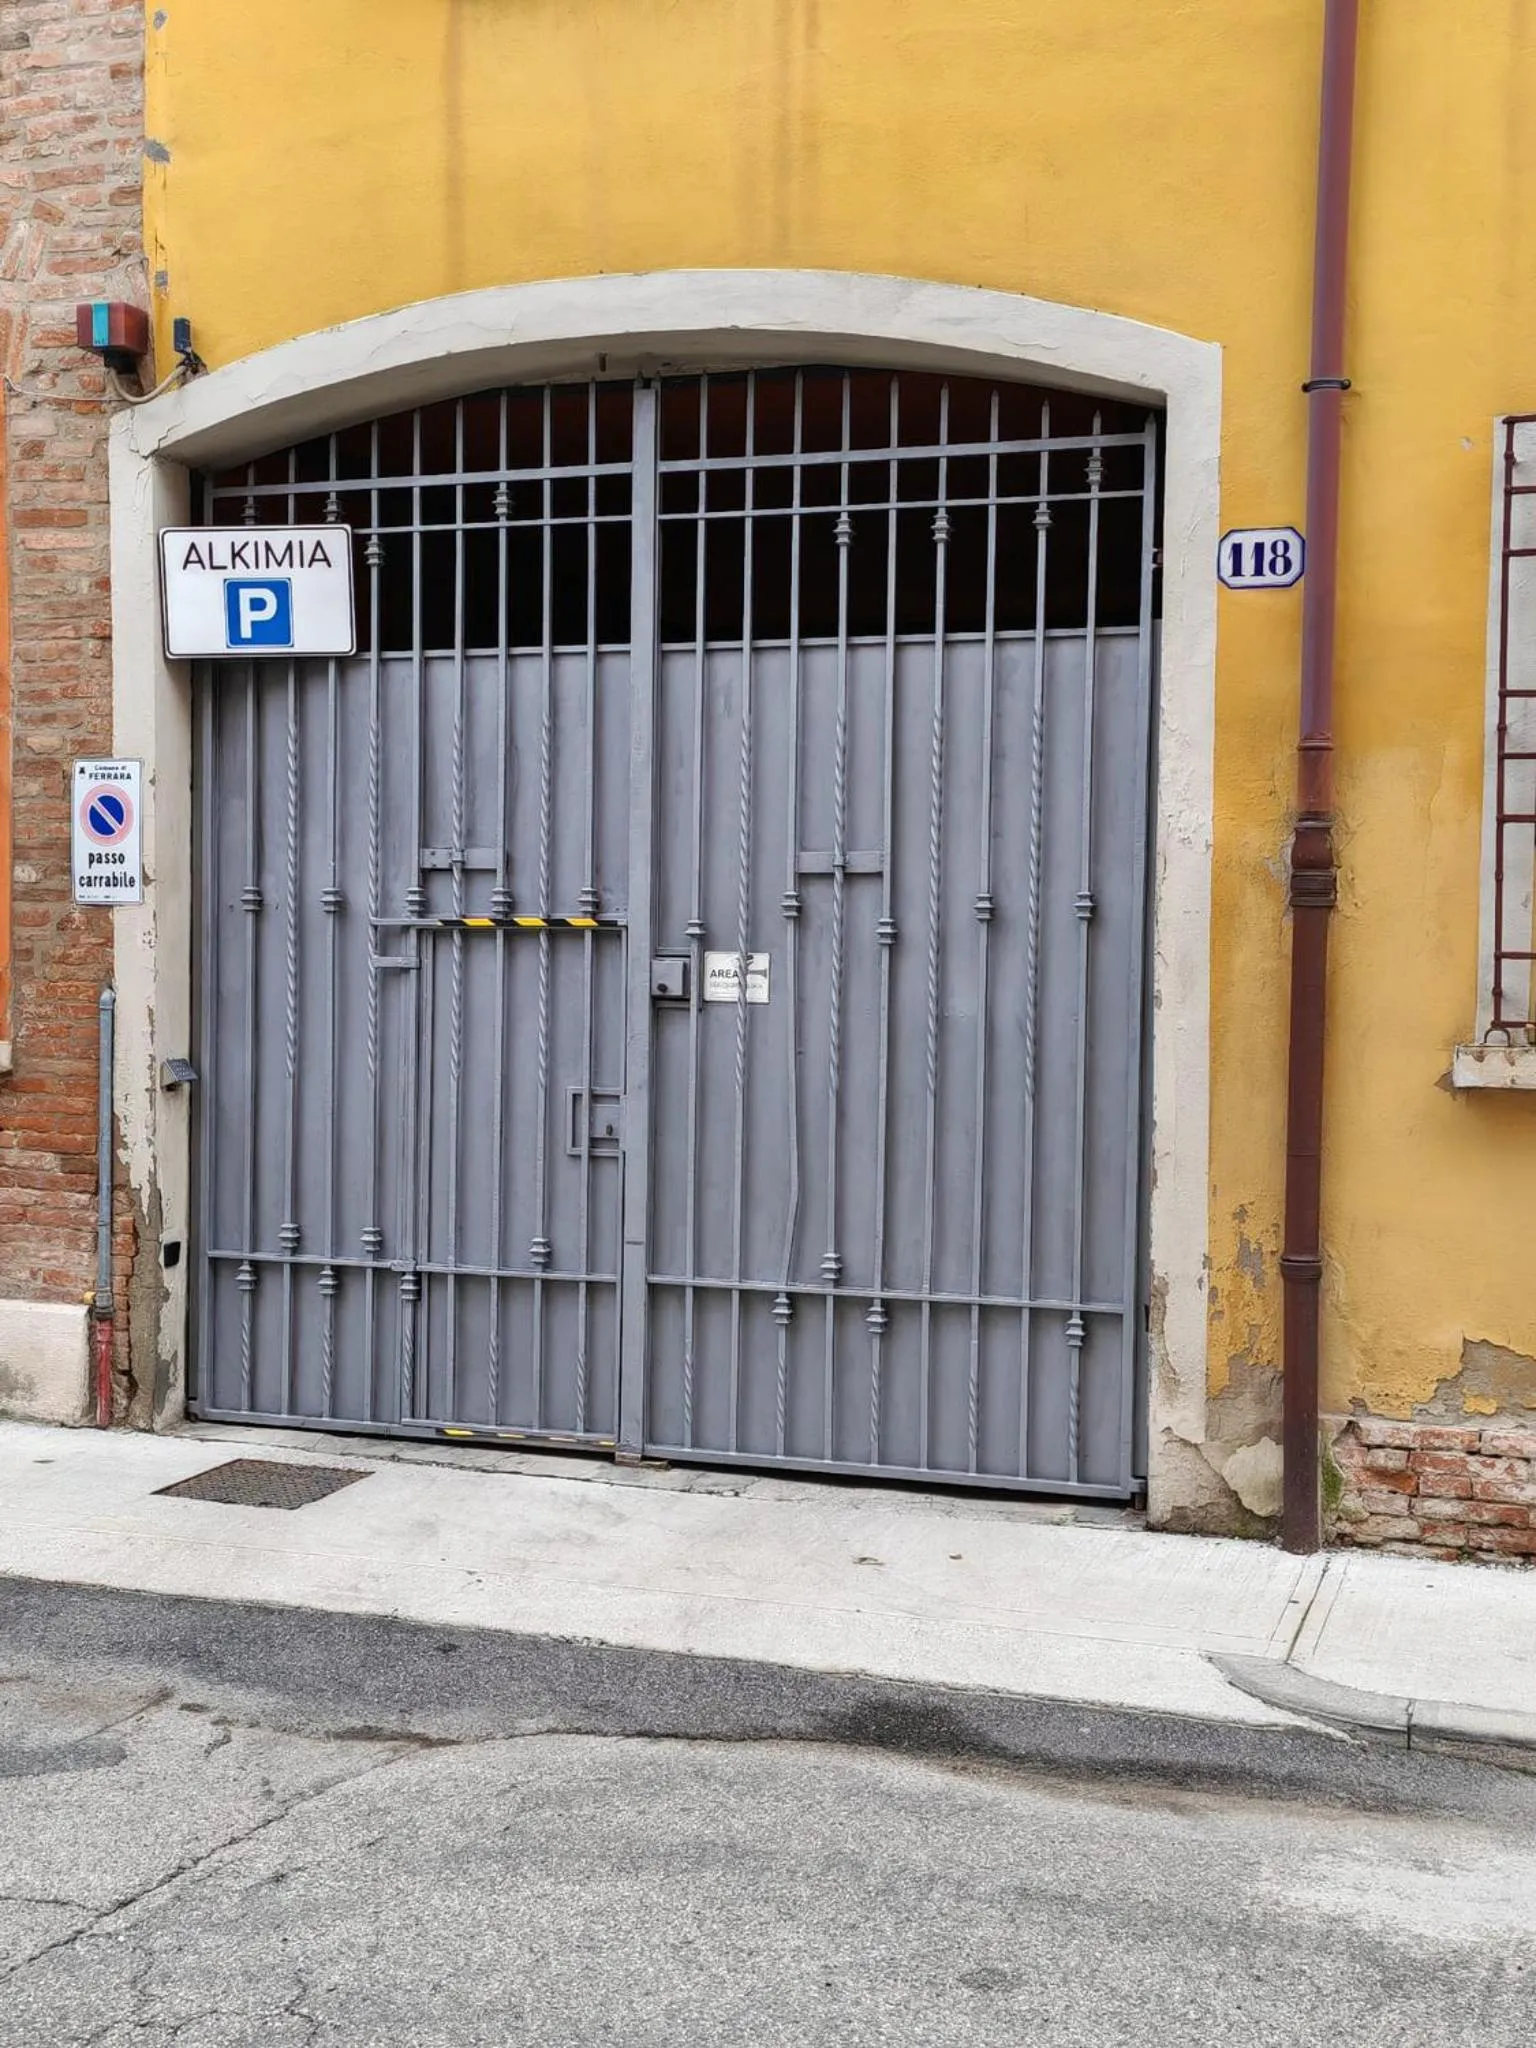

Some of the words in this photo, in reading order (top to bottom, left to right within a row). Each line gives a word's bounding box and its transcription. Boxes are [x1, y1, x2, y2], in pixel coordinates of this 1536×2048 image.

[182, 539, 332, 571] ALKIMIA
[1228, 538, 1293, 577] 118
[238, 587, 278, 639] P
[88, 772, 132, 780] FERRARA
[88, 852, 125, 869] passo
[79, 871, 136, 888] carrabile
[709, 968, 739, 979] AREA
